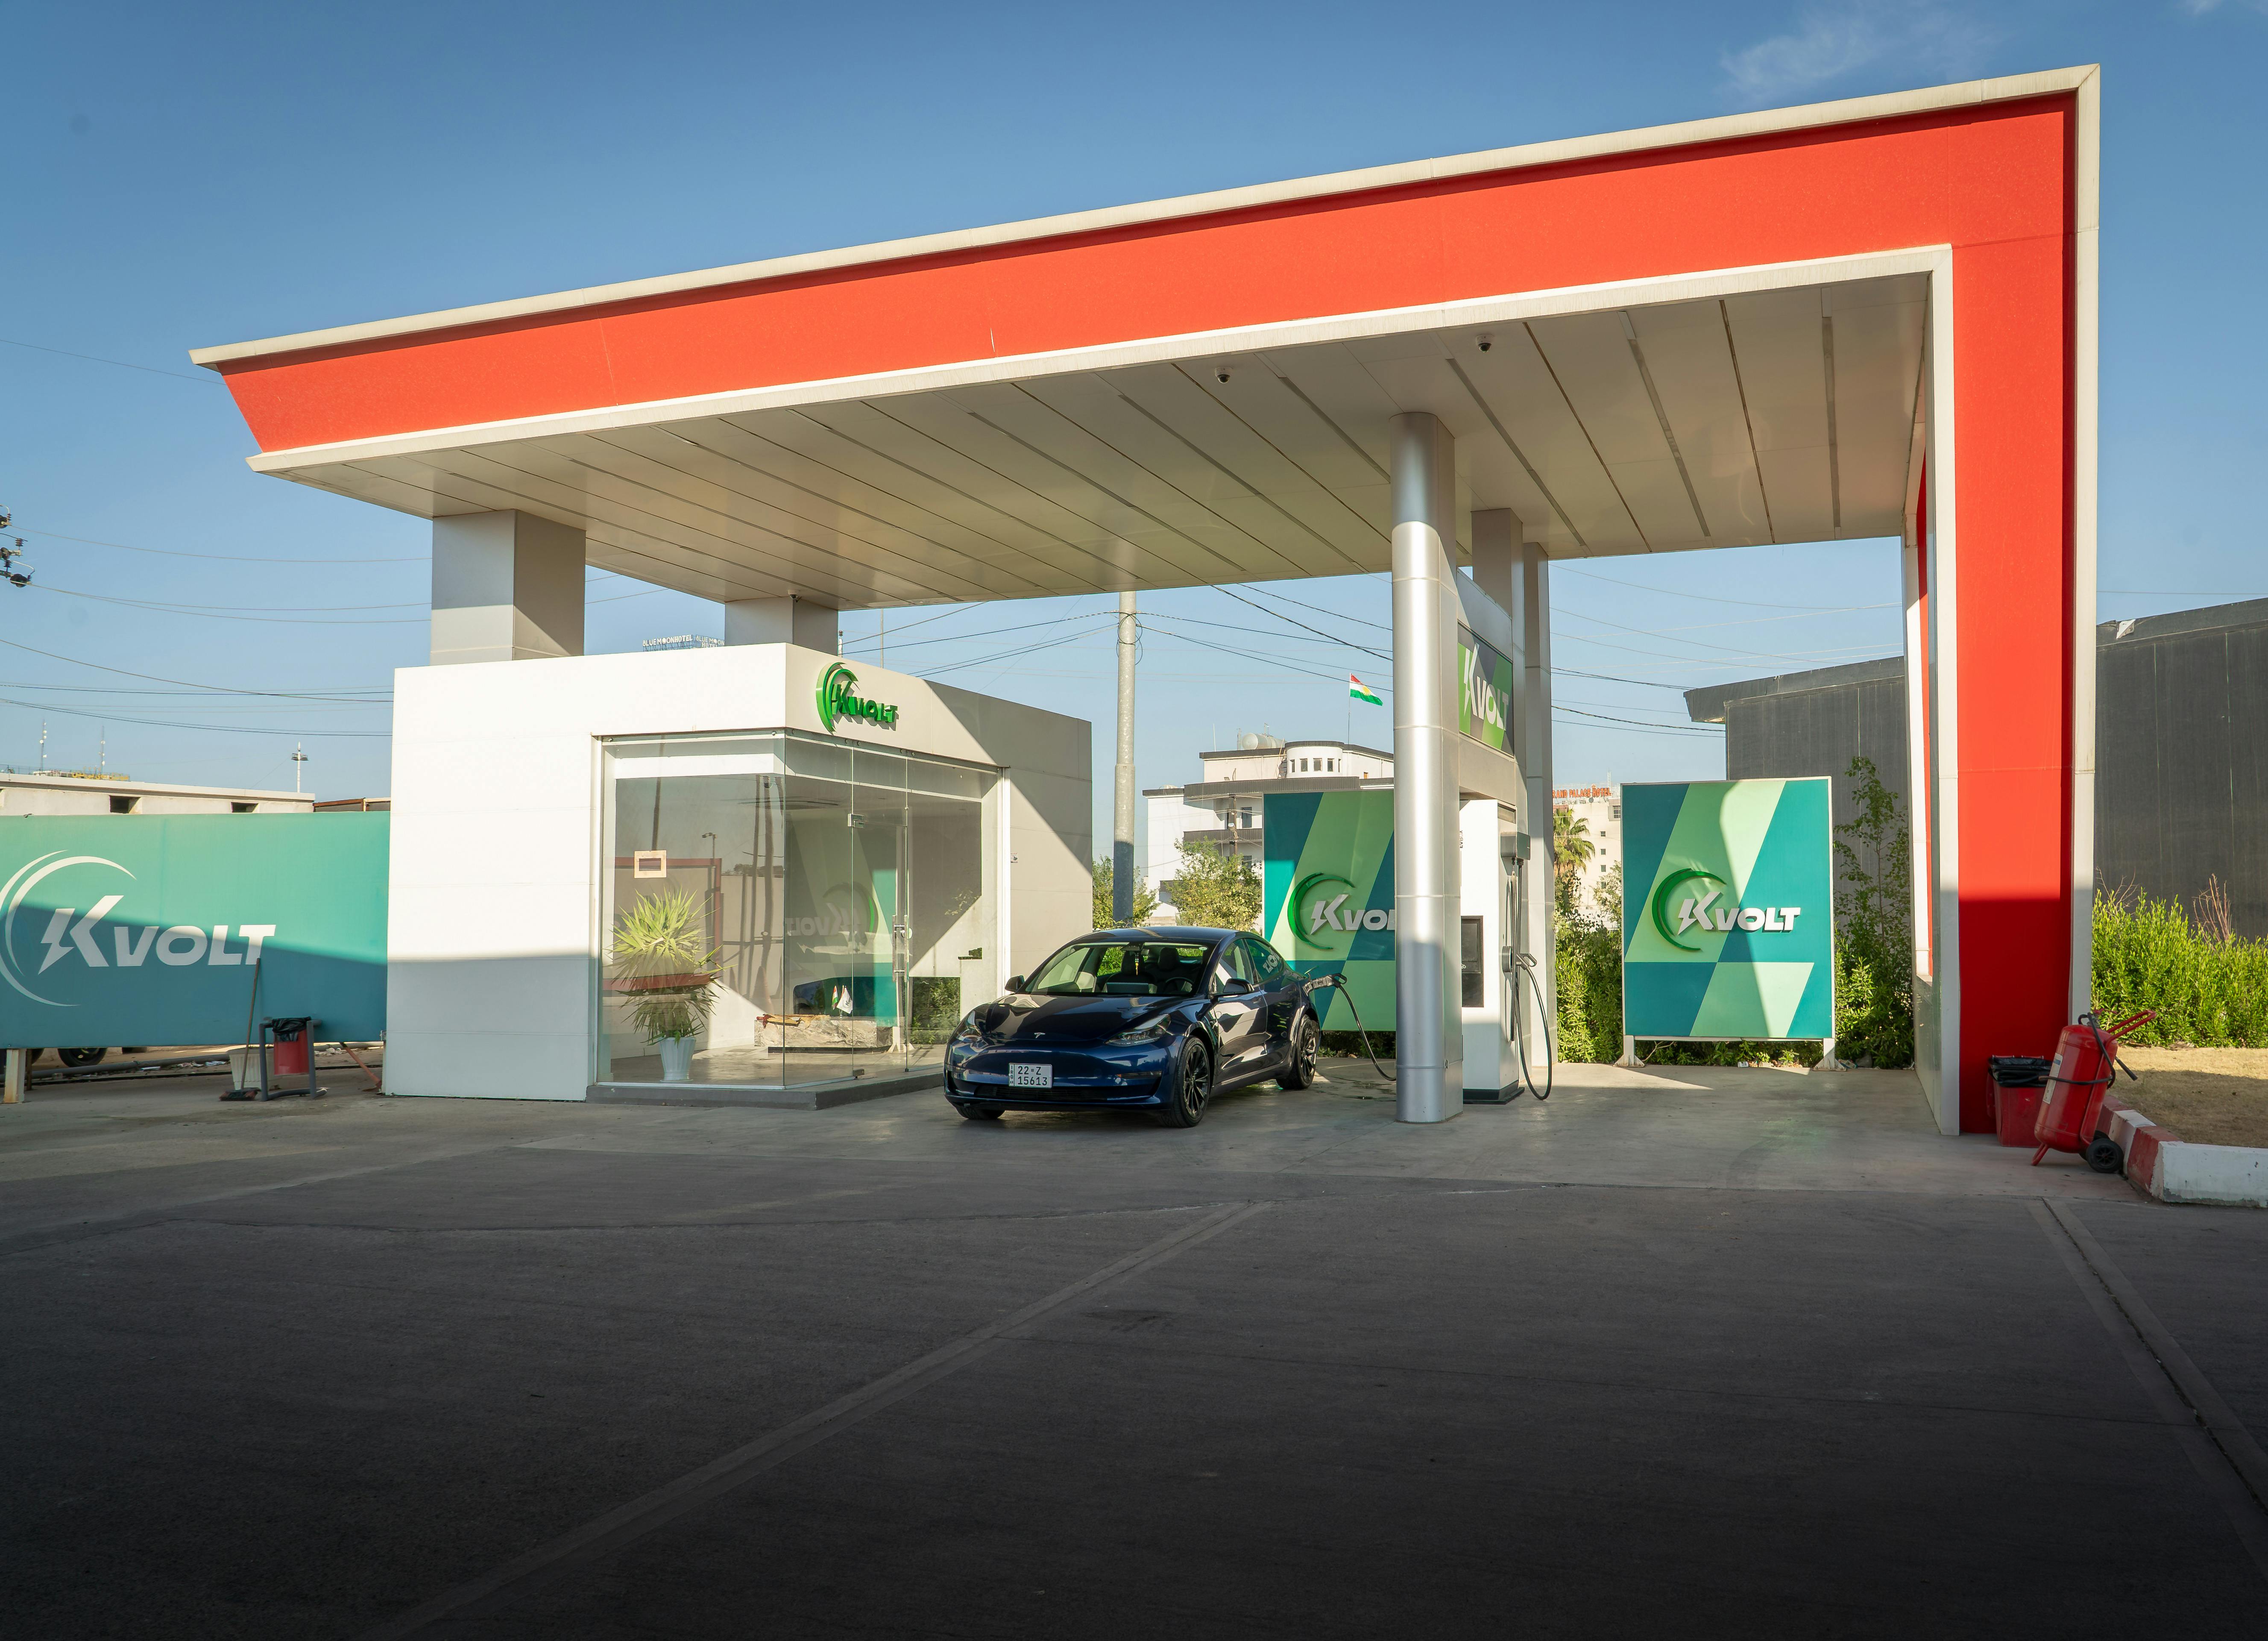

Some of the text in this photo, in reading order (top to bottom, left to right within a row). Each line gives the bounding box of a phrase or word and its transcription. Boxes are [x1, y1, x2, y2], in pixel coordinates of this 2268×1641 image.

[674, 634, 693, 643] HOTEL
[1464, 642, 1509, 731] KVOLT
[1552, 788, 1612, 798] RAND PALACE HOTEL
[1677, 892, 1801, 936] KVOLT
[38, 895, 276, 975] KVOLT
[1018, 1066, 1041, 1075] 22 Z
[1017, 1076, 1047, 1086] 15613
